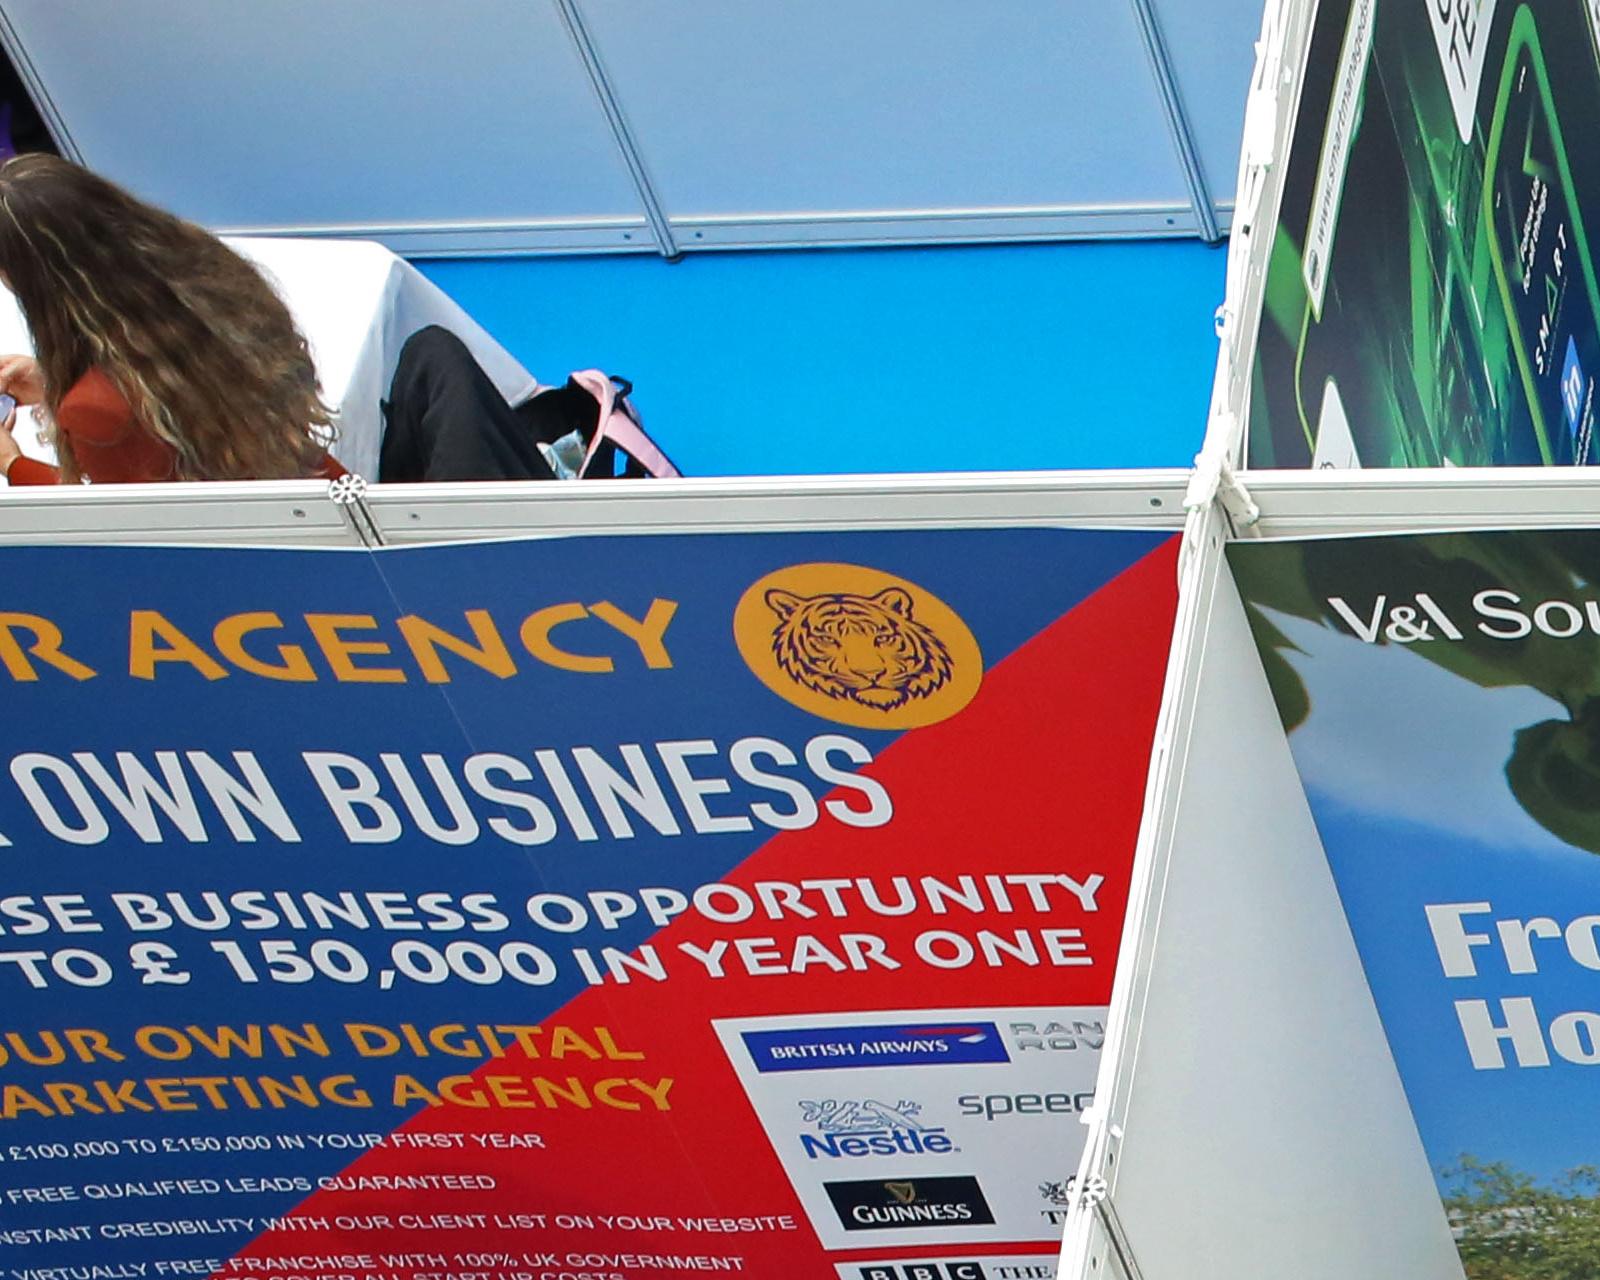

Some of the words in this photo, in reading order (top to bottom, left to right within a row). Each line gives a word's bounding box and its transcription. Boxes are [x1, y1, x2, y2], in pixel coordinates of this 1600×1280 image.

[129, 598, 677, 683] AGENCY
[9, 750, 302, 845] OWN
[301, 734, 893, 846] BUSINESS
[111, 891, 510, 932] BUSINESS
[526, 873, 1105, 933] OPPORTUNITY
[0, 948, 113, 988] TO
[129, 941, 191, 985] £
[210, 939, 557, 990] 150,000
[572, 944, 668, 986] IN
[677, 933, 902, 978] YEAR
[914, 928, 1094, 969] ONE
[135, 1024, 330, 1060] OWN
[345, 1024, 645, 1060] DIGITAL
[770, 1042, 855, 1059] BRITISH
[860, 1039, 949, 1055] AIRWAYS
[393, 1075, 673, 1111] AGENCY
[8, 1140, 120, 1161] £100,000
[121, 1139, 157, 1154] TO
[161, 1135, 272, 1153] £150,000
[276, 1134, 305, 1150] IN
[307, 1133, 388, 1149] YOUR
[390, 1133, 464, 1148] FIRST
[470, 1133, 546, 1149] YEAR
[6, 1186, 80, 1205] FREE
[83, 1179, 221, 1199] QUALIFIED
[224, 1177, 312, 1193] LEADS
[317, 1175, 496, 1191] GUARANTEED
[100, 1218, 254, 1239] CREDIBILITY
[260, 1216, 330, 1232] WITH
[335, 1215, 394, 1230] OUR
[398, 1214, 486, 1229] CLIENT
[493, 1214, 546, 1229] LIST
[555, 1215, 595, 1229] ON
[597, 1215, 675, 1231] YOUR
[677, 1215, 797, 1233] WEBSITE
[852, 1203, 972, 1224] GUINNESS
[154, 1259, 226, 1276] FREE
[228, 1254, 377, 1272] FRANCHISE
[379, 1253, 448, 1268] WITH
[453, 1253, 519, 1267] 100%
[522, 1253, 561, 1267] UK
[565, 1253, 743, 1271] GOVERNMENT
